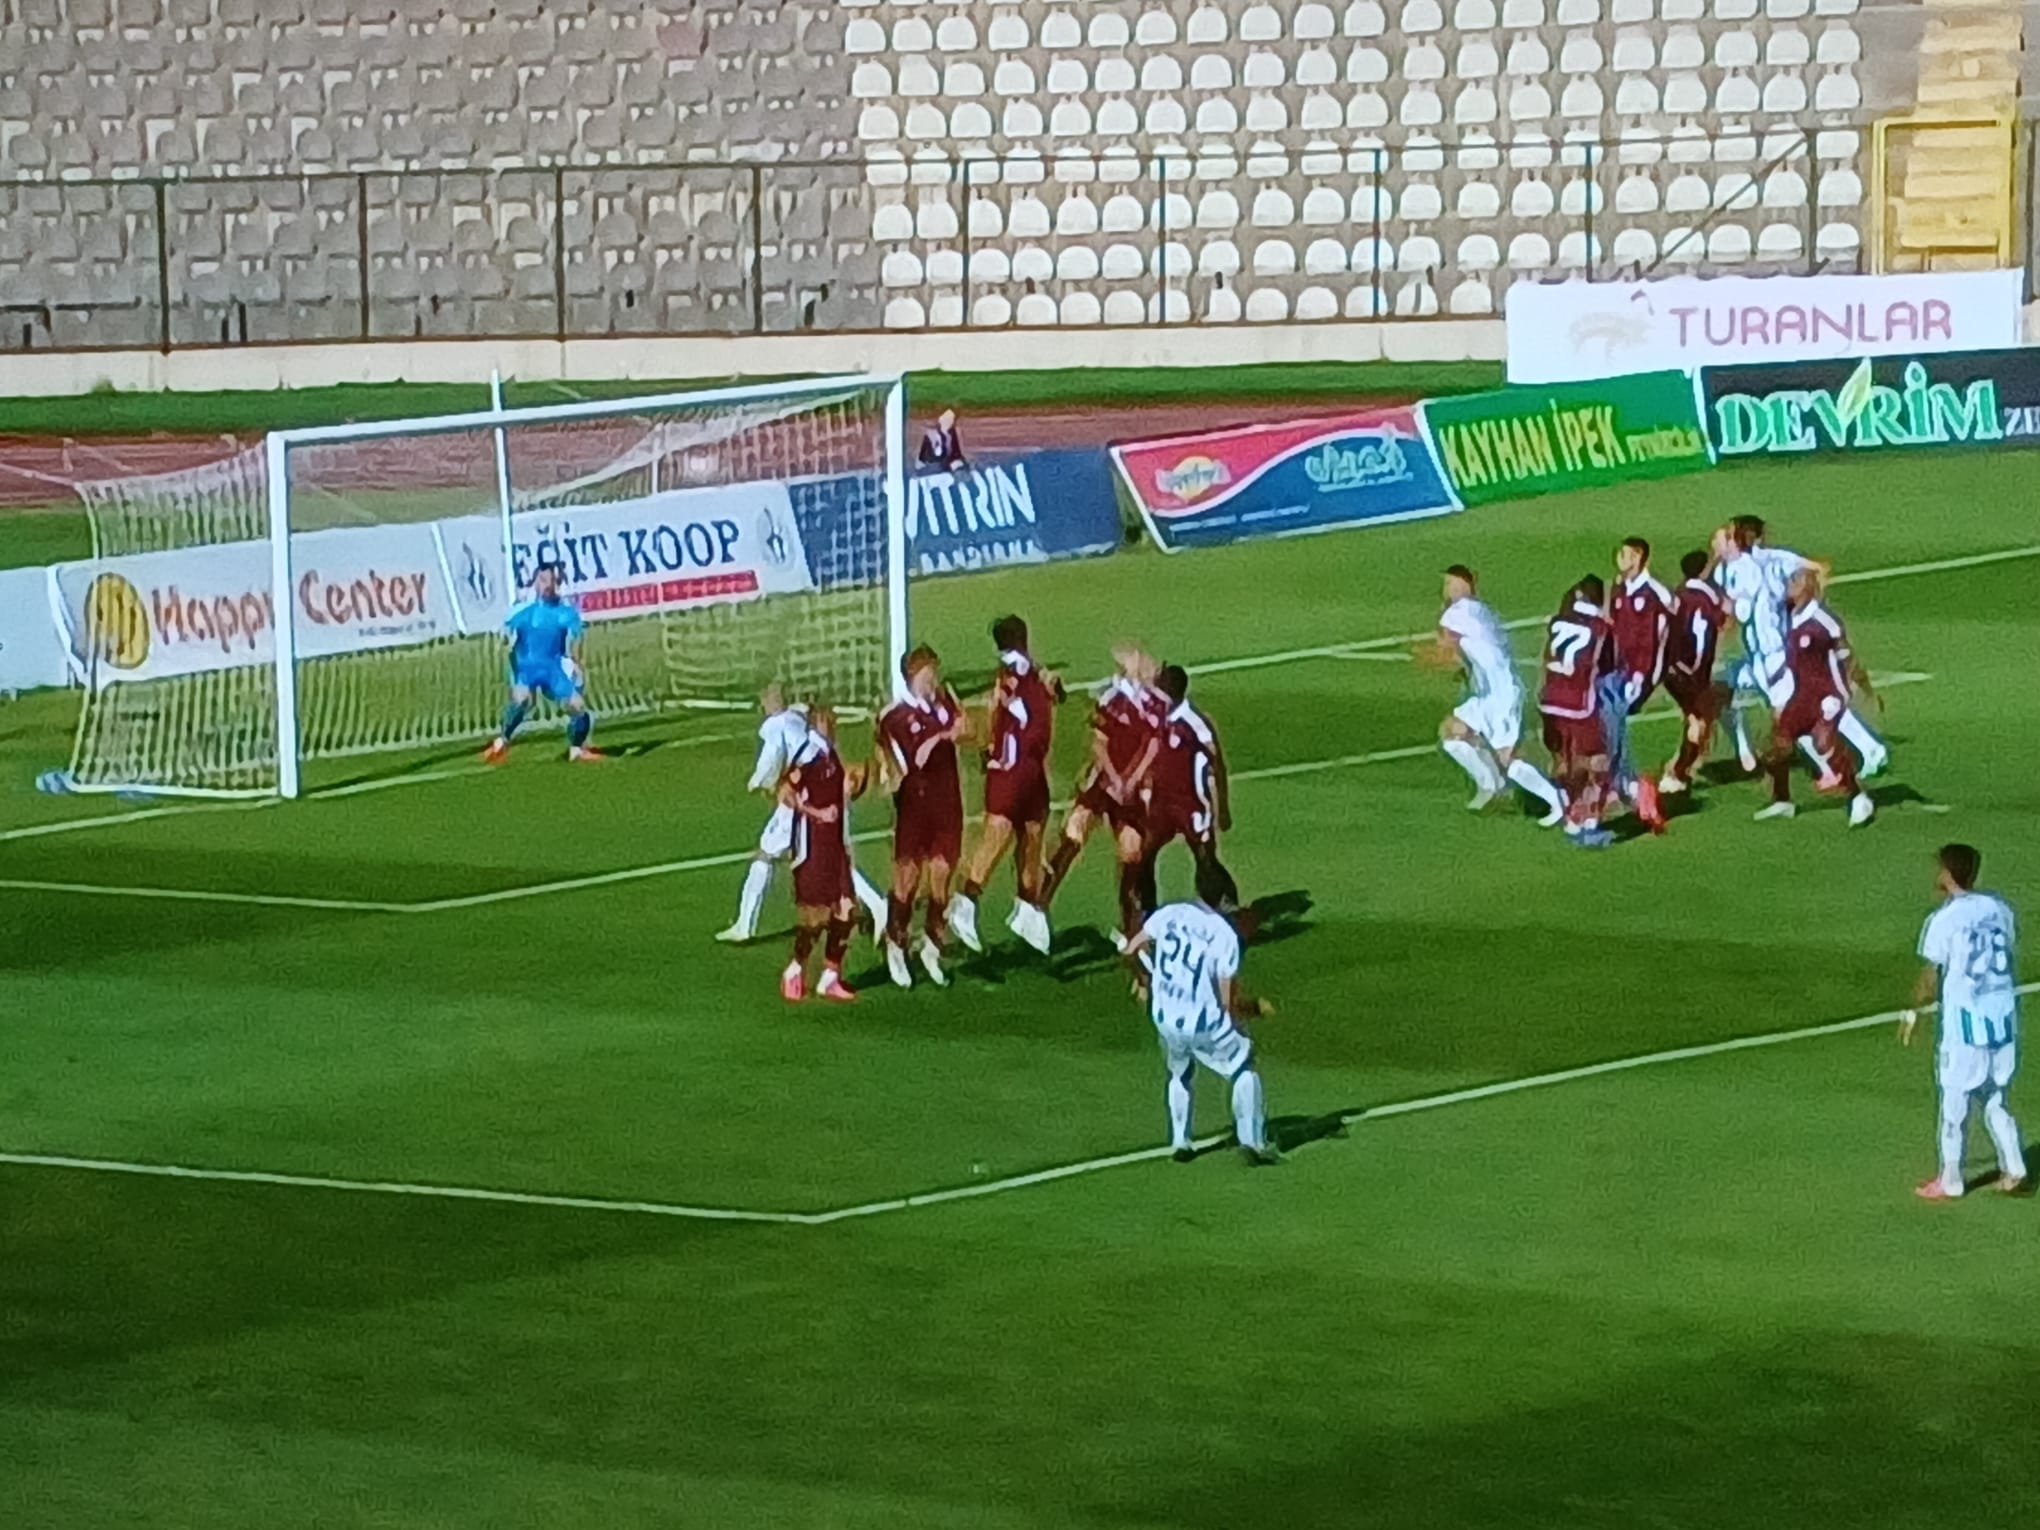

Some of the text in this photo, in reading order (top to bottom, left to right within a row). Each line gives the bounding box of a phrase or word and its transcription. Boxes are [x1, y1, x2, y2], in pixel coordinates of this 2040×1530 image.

[1669, 298, 1953, 347] TURANLAR
[1438, 414, 1558, 490] KAYHAN
[1549, 398, 1627, 472] İPEK
[618, 519, 740, 577] KOOP
[299, 568, 427, 625] Center
[1159, 930, 1206, 1003] 24
